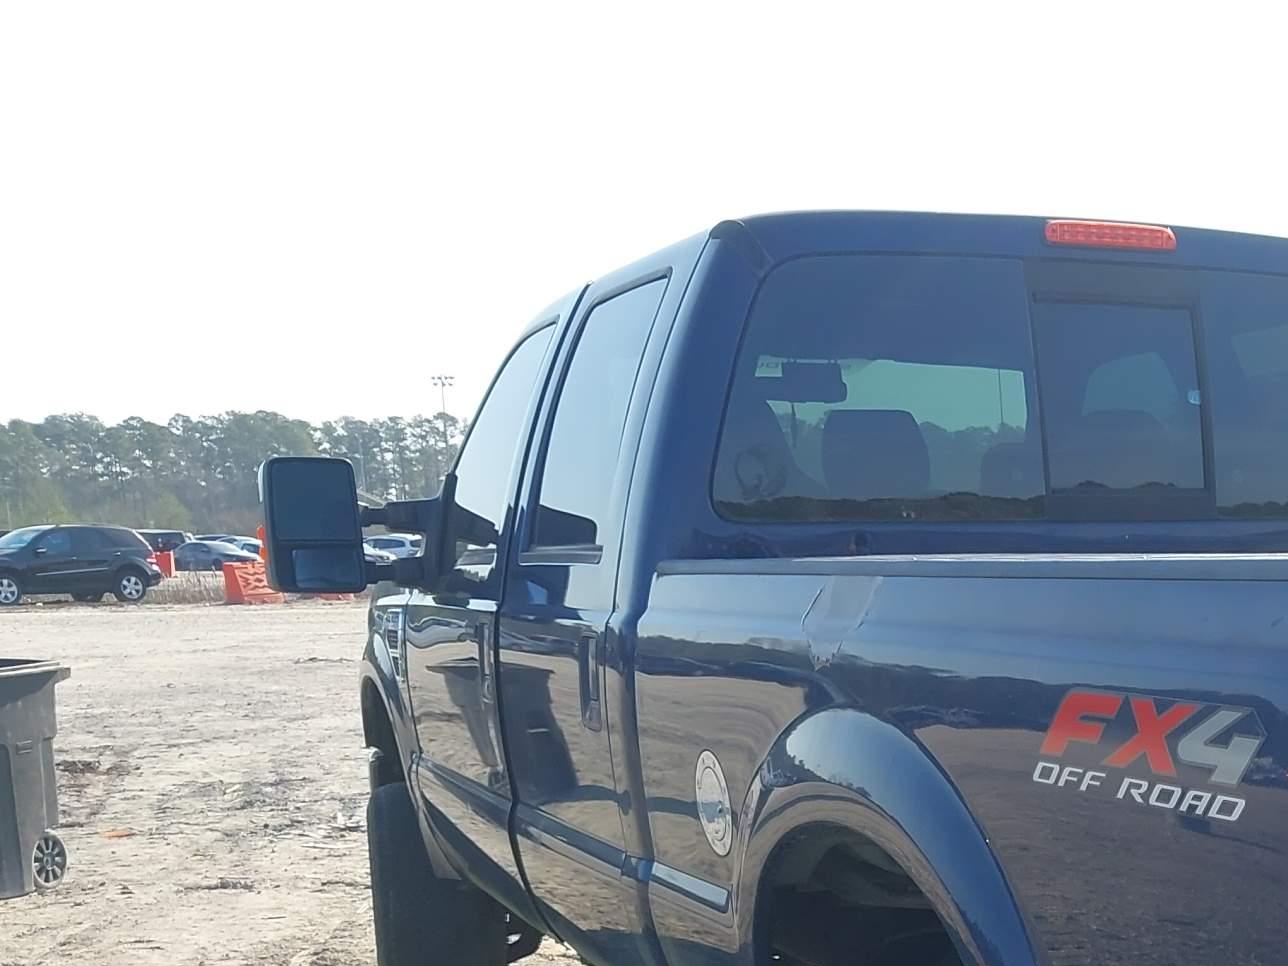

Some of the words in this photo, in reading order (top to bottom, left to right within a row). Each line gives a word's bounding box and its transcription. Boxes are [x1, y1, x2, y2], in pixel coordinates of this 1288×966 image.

[1039, 687, 1268, 788] FX4
[1032, 761, 1106, 792] OFF
[1116, 777, 1246, 822] ROAD
